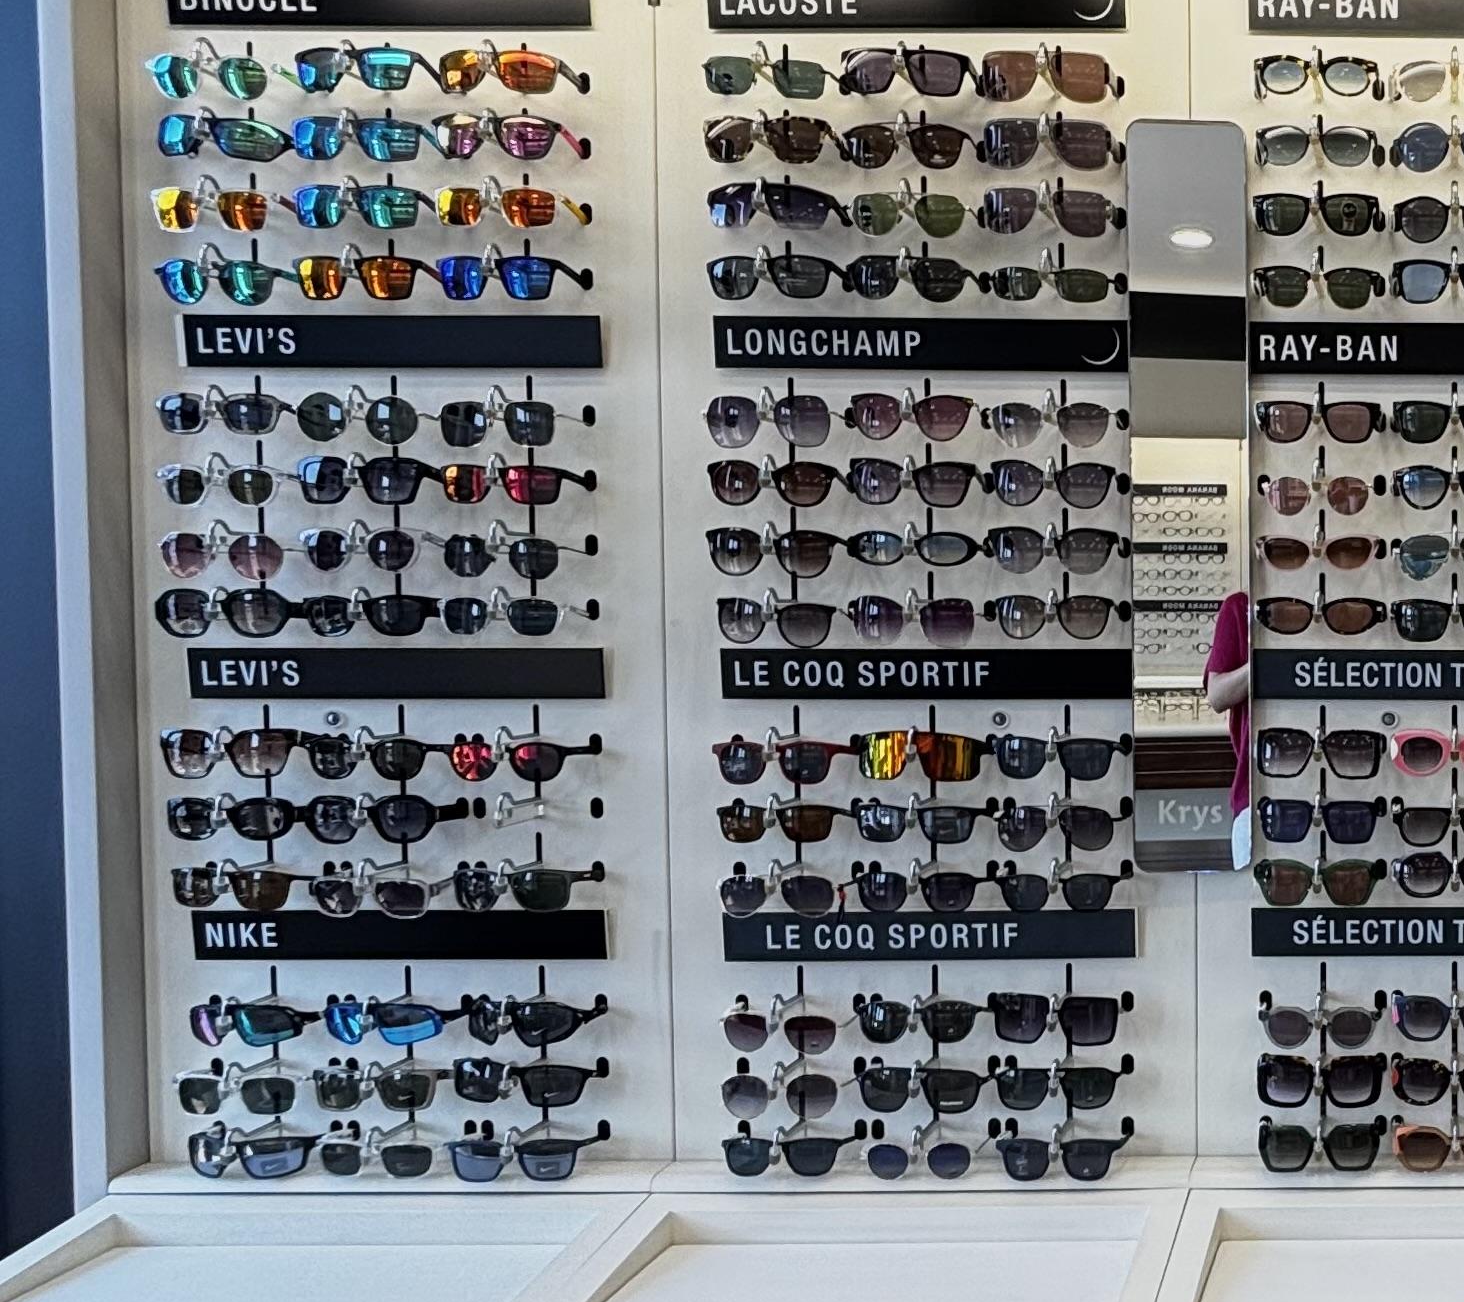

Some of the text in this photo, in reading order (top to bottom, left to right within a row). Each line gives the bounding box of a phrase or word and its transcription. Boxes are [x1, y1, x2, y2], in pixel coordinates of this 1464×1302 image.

[197, 328, 295, 354] LEVI'S
[727, 329, 920, 356] LONGCHAMP
[1260, 335, 1397, 361] RAY-BAN
[201, 661, 299, 686] LEVI'S
[735, 661, 989, 687] LE COQ SPORTIF
[1295, 657, 1441, 687] SÉLECTION
[1159, 800, 1222, 832] Krys
[205, 923, 278, 947] NIKE
[767, 923, 1017, 950] LE COQ SPORTIF
[1293, 915, 1443, 944] SÉLECTION
